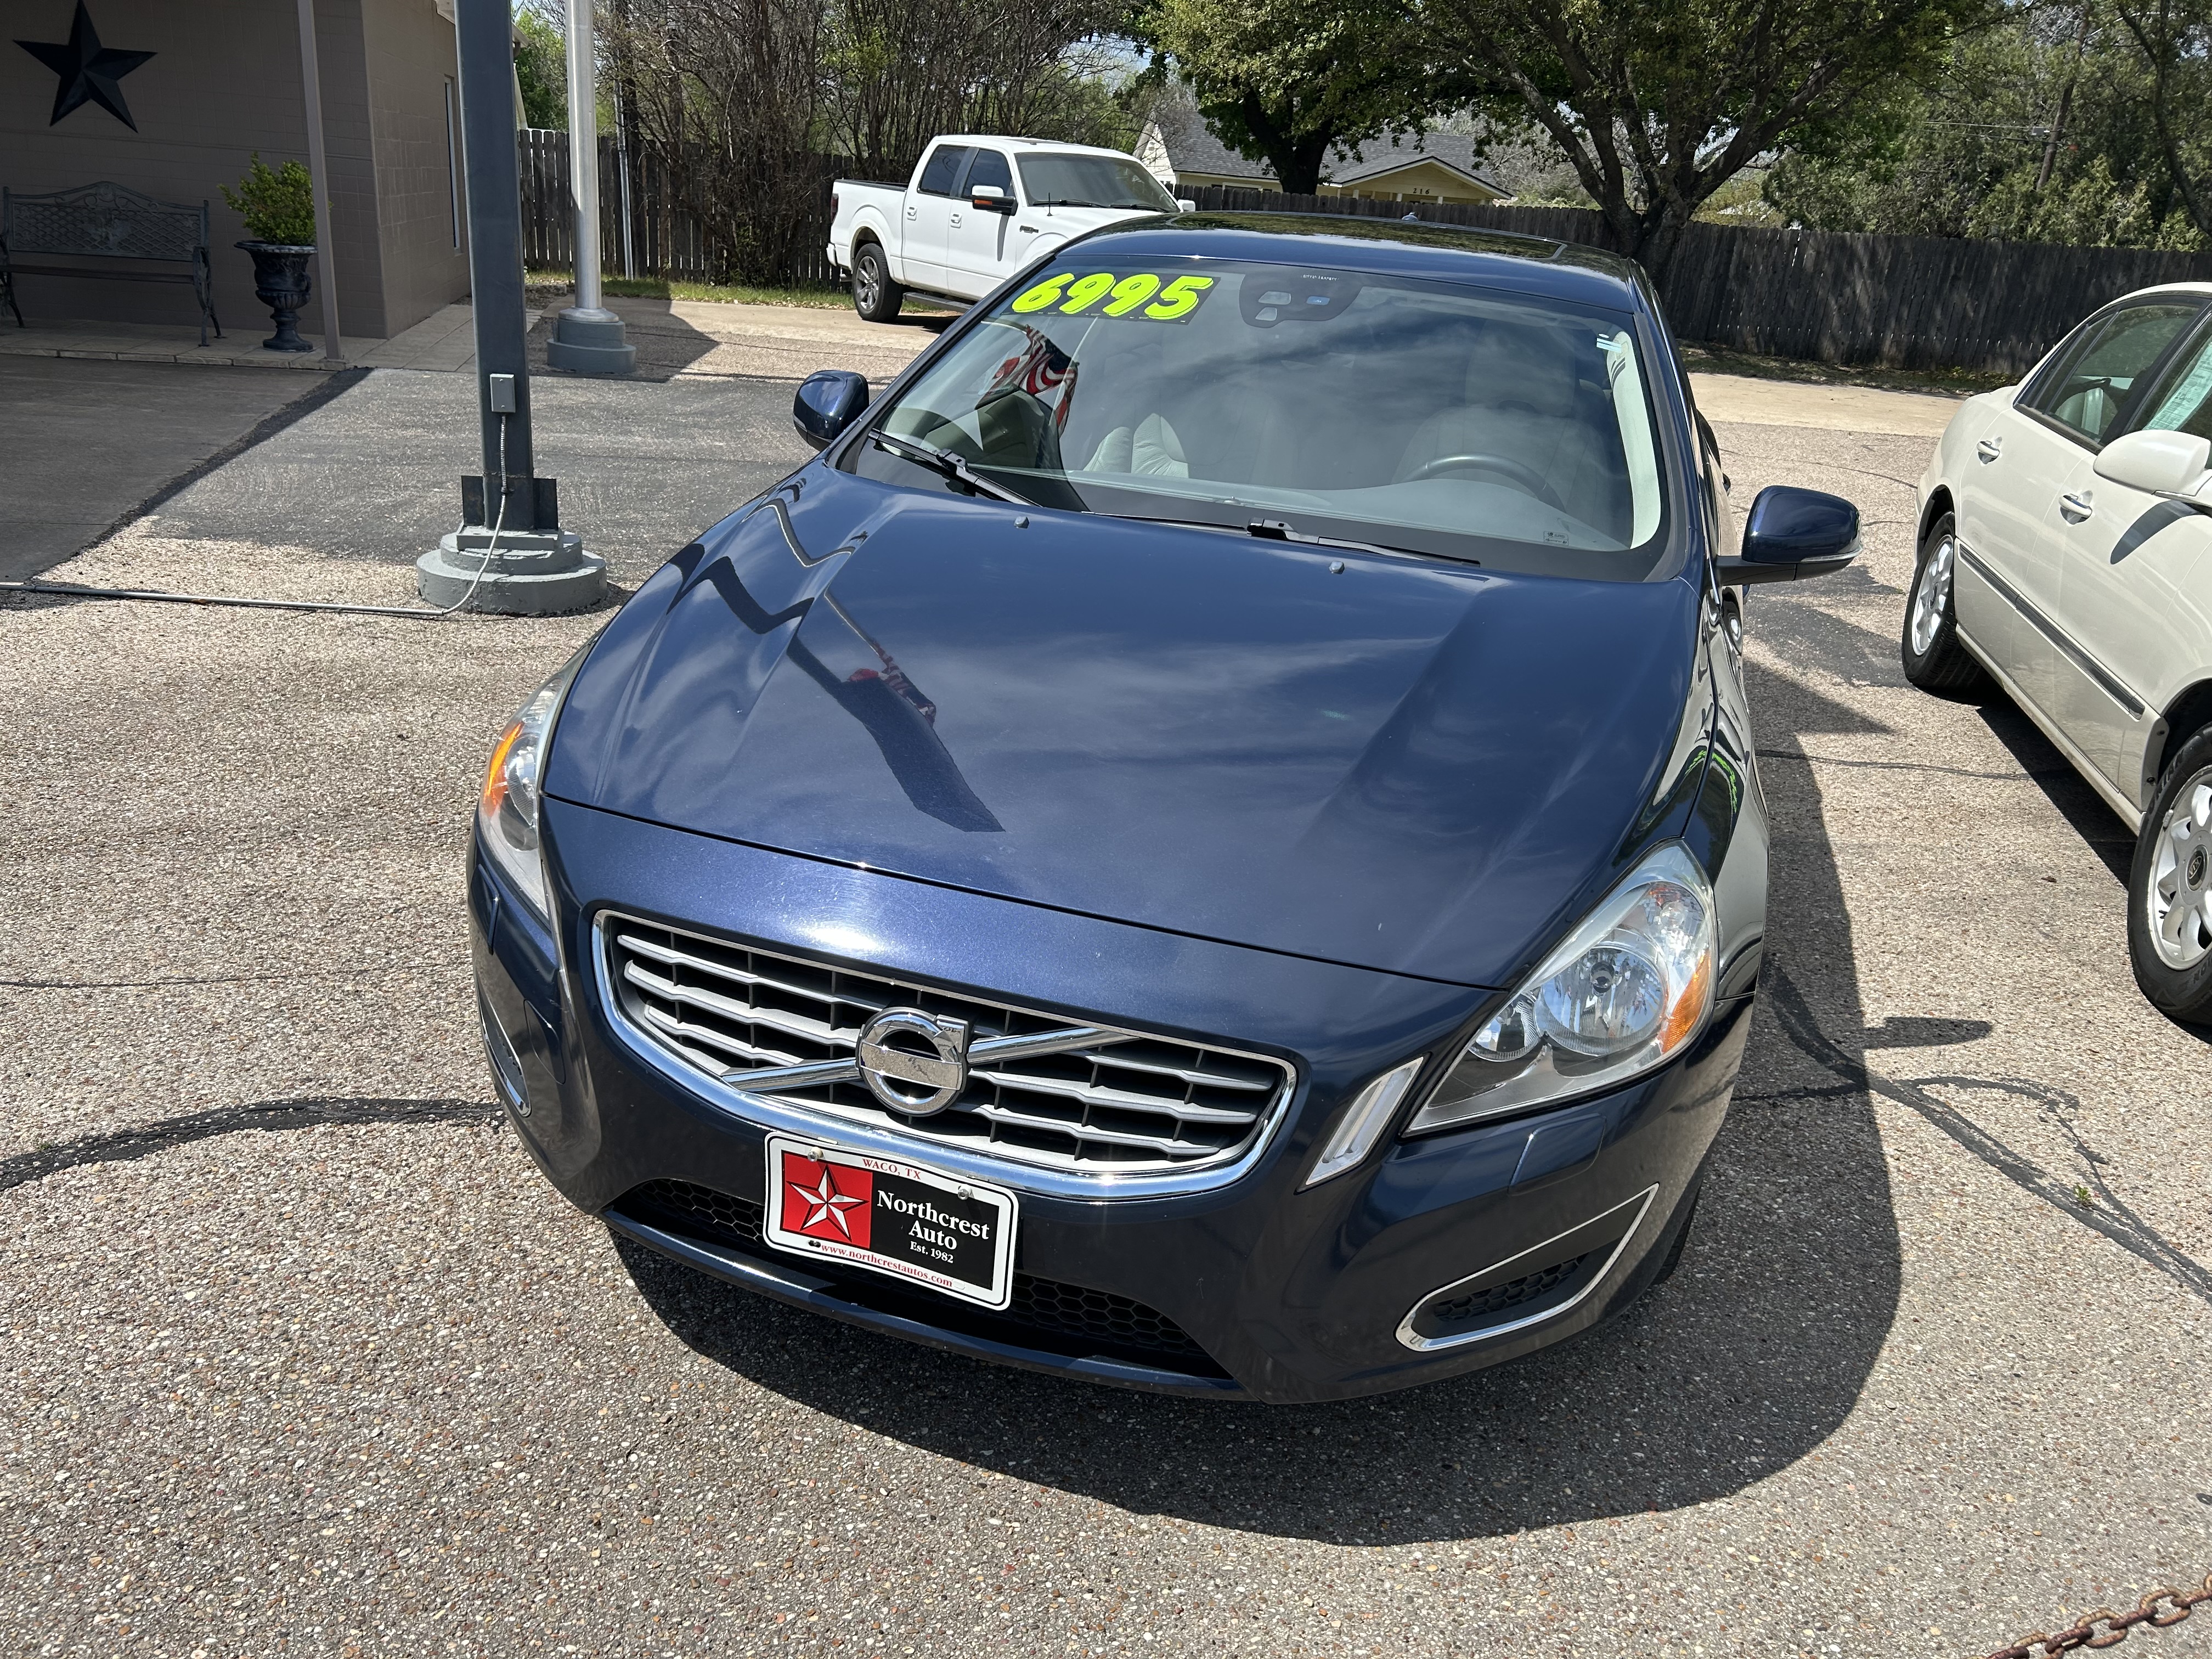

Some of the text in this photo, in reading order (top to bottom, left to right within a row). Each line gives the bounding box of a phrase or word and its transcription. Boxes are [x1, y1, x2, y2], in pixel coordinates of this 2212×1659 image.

[1012, 273, 1214, 320] 6995
[862, 1158, 922, 1180] WACO, TX
[877, 1189, 990, 1240] Northcrest
[909, 1220, 957, 1250] Auto
[910, 1241, 954, 1264] Est. 1982
[821, 1244, 952, 1288] www.northcrestautos.com
